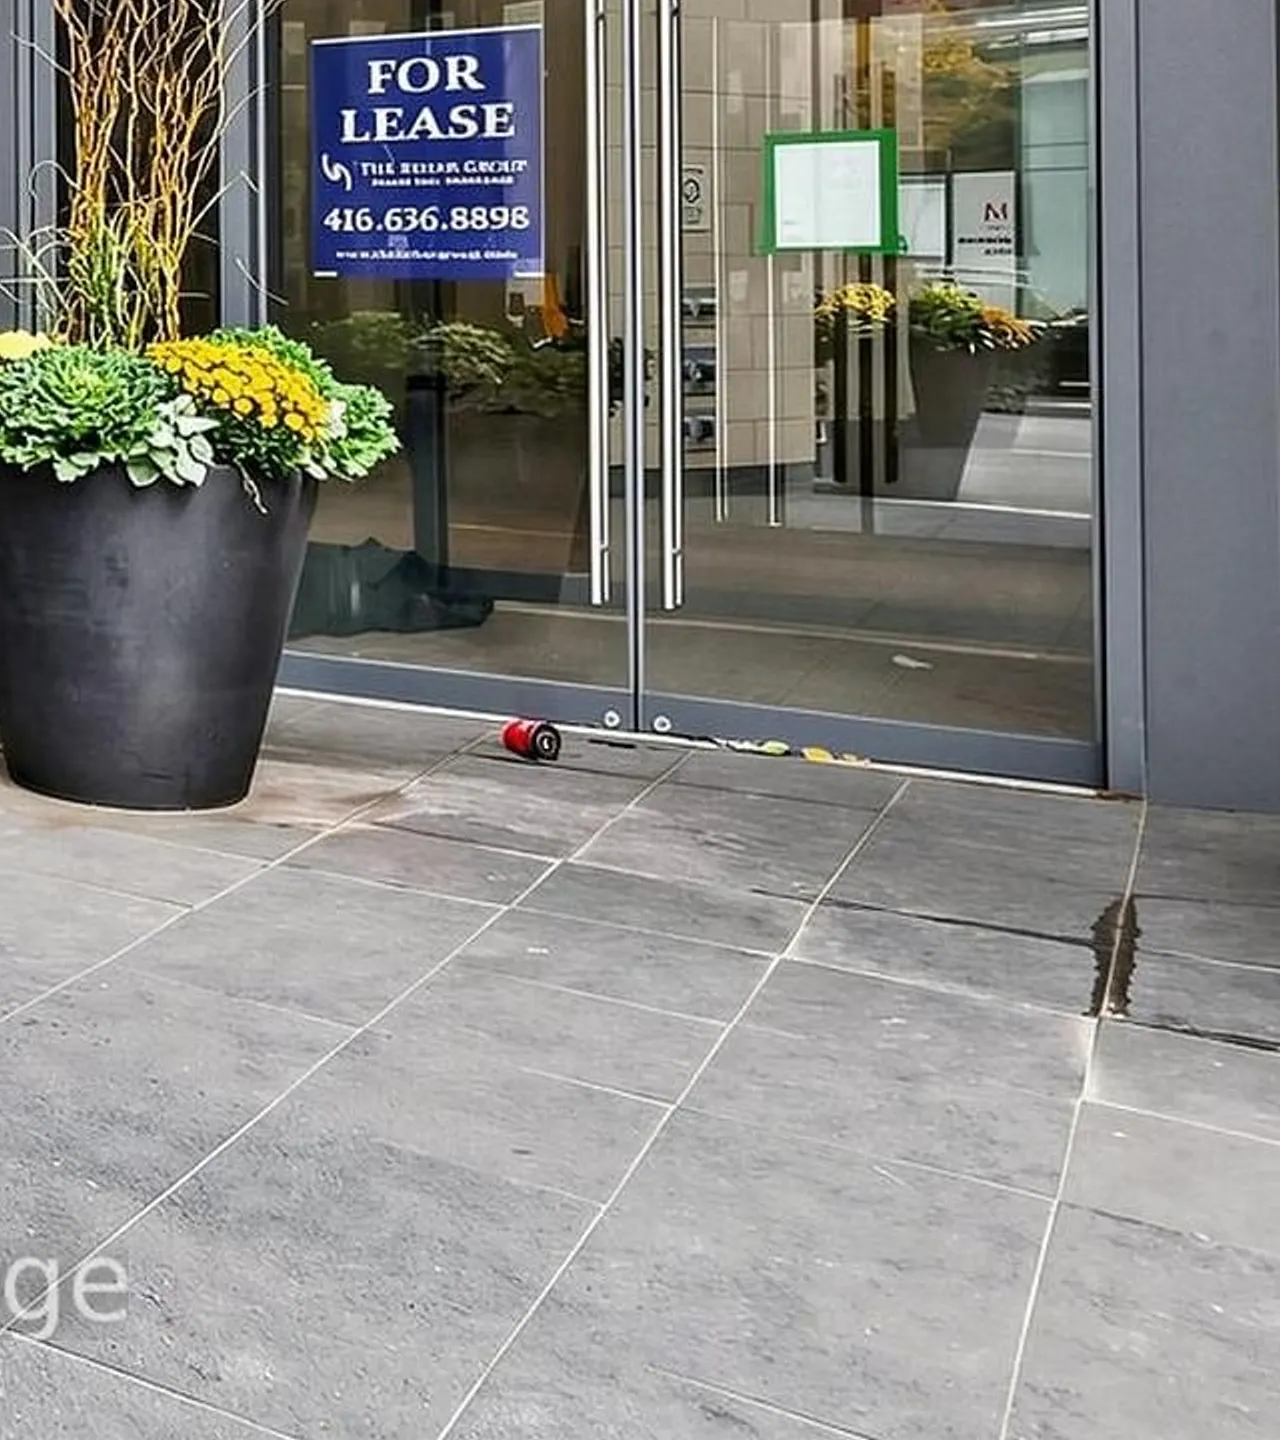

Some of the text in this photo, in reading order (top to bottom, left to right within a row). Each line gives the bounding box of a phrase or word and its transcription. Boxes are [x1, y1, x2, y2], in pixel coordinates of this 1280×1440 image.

[368, 54, 485, 94] FOR
[340, 102, 515, 143] LEASE
[323, 206, 530, 232] 416.636.8898
